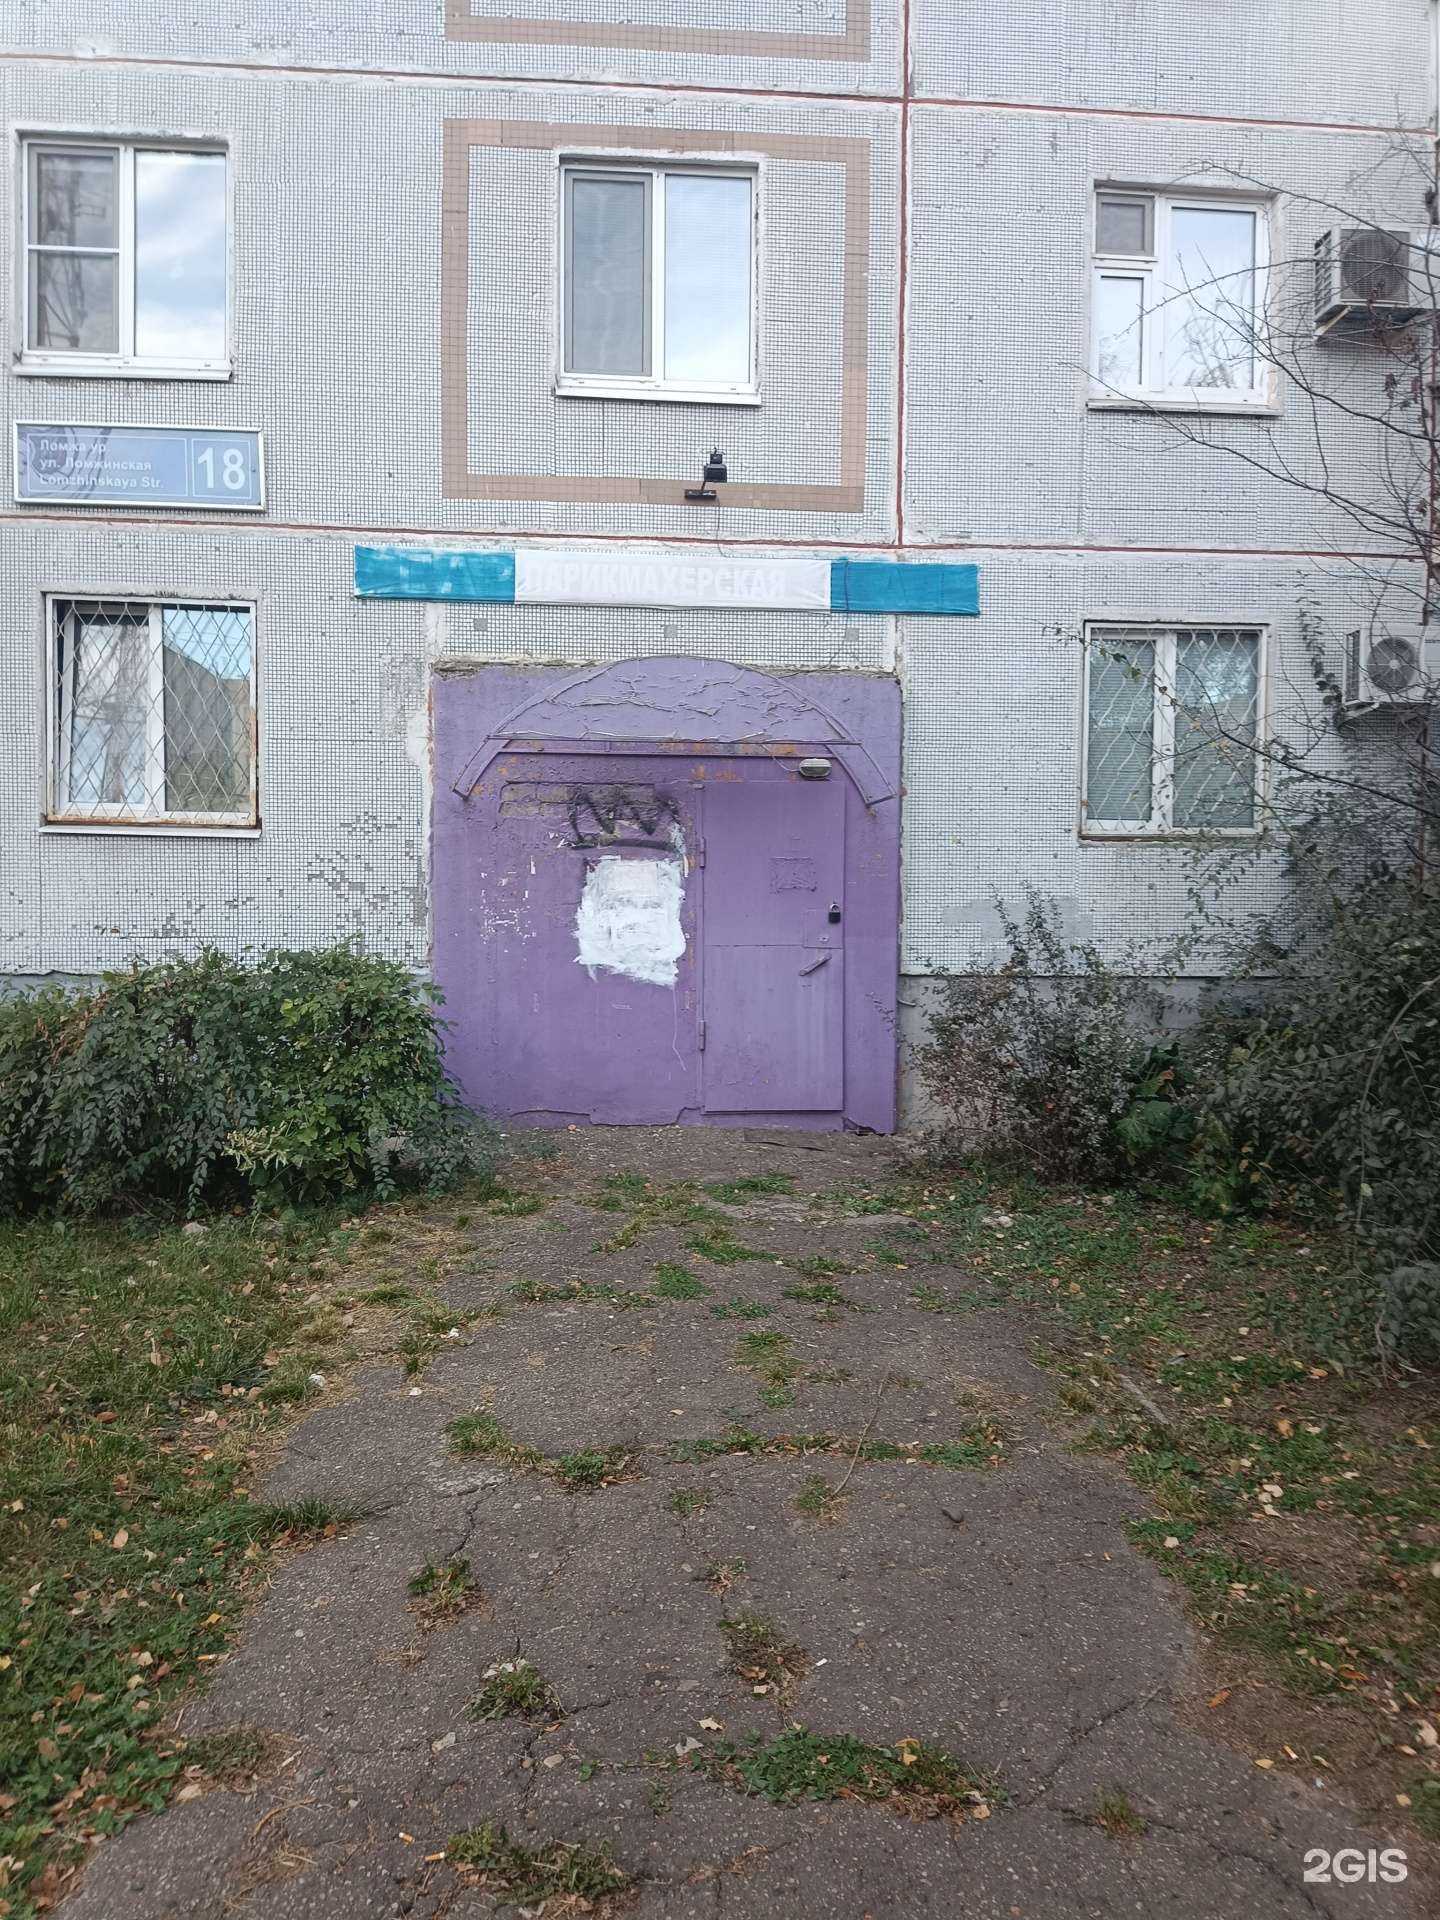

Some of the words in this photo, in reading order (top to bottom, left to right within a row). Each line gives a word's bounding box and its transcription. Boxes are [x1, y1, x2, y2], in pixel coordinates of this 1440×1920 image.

[40, 459, 61, 471] ул.
[65, 457, 152, 471] Ломжинская
[198, 447, 245, 490] 18
[141, 476, 164, 489] Str.
[525, 561, 786, 599] ПАРИКМАХЕРСКАЯ
